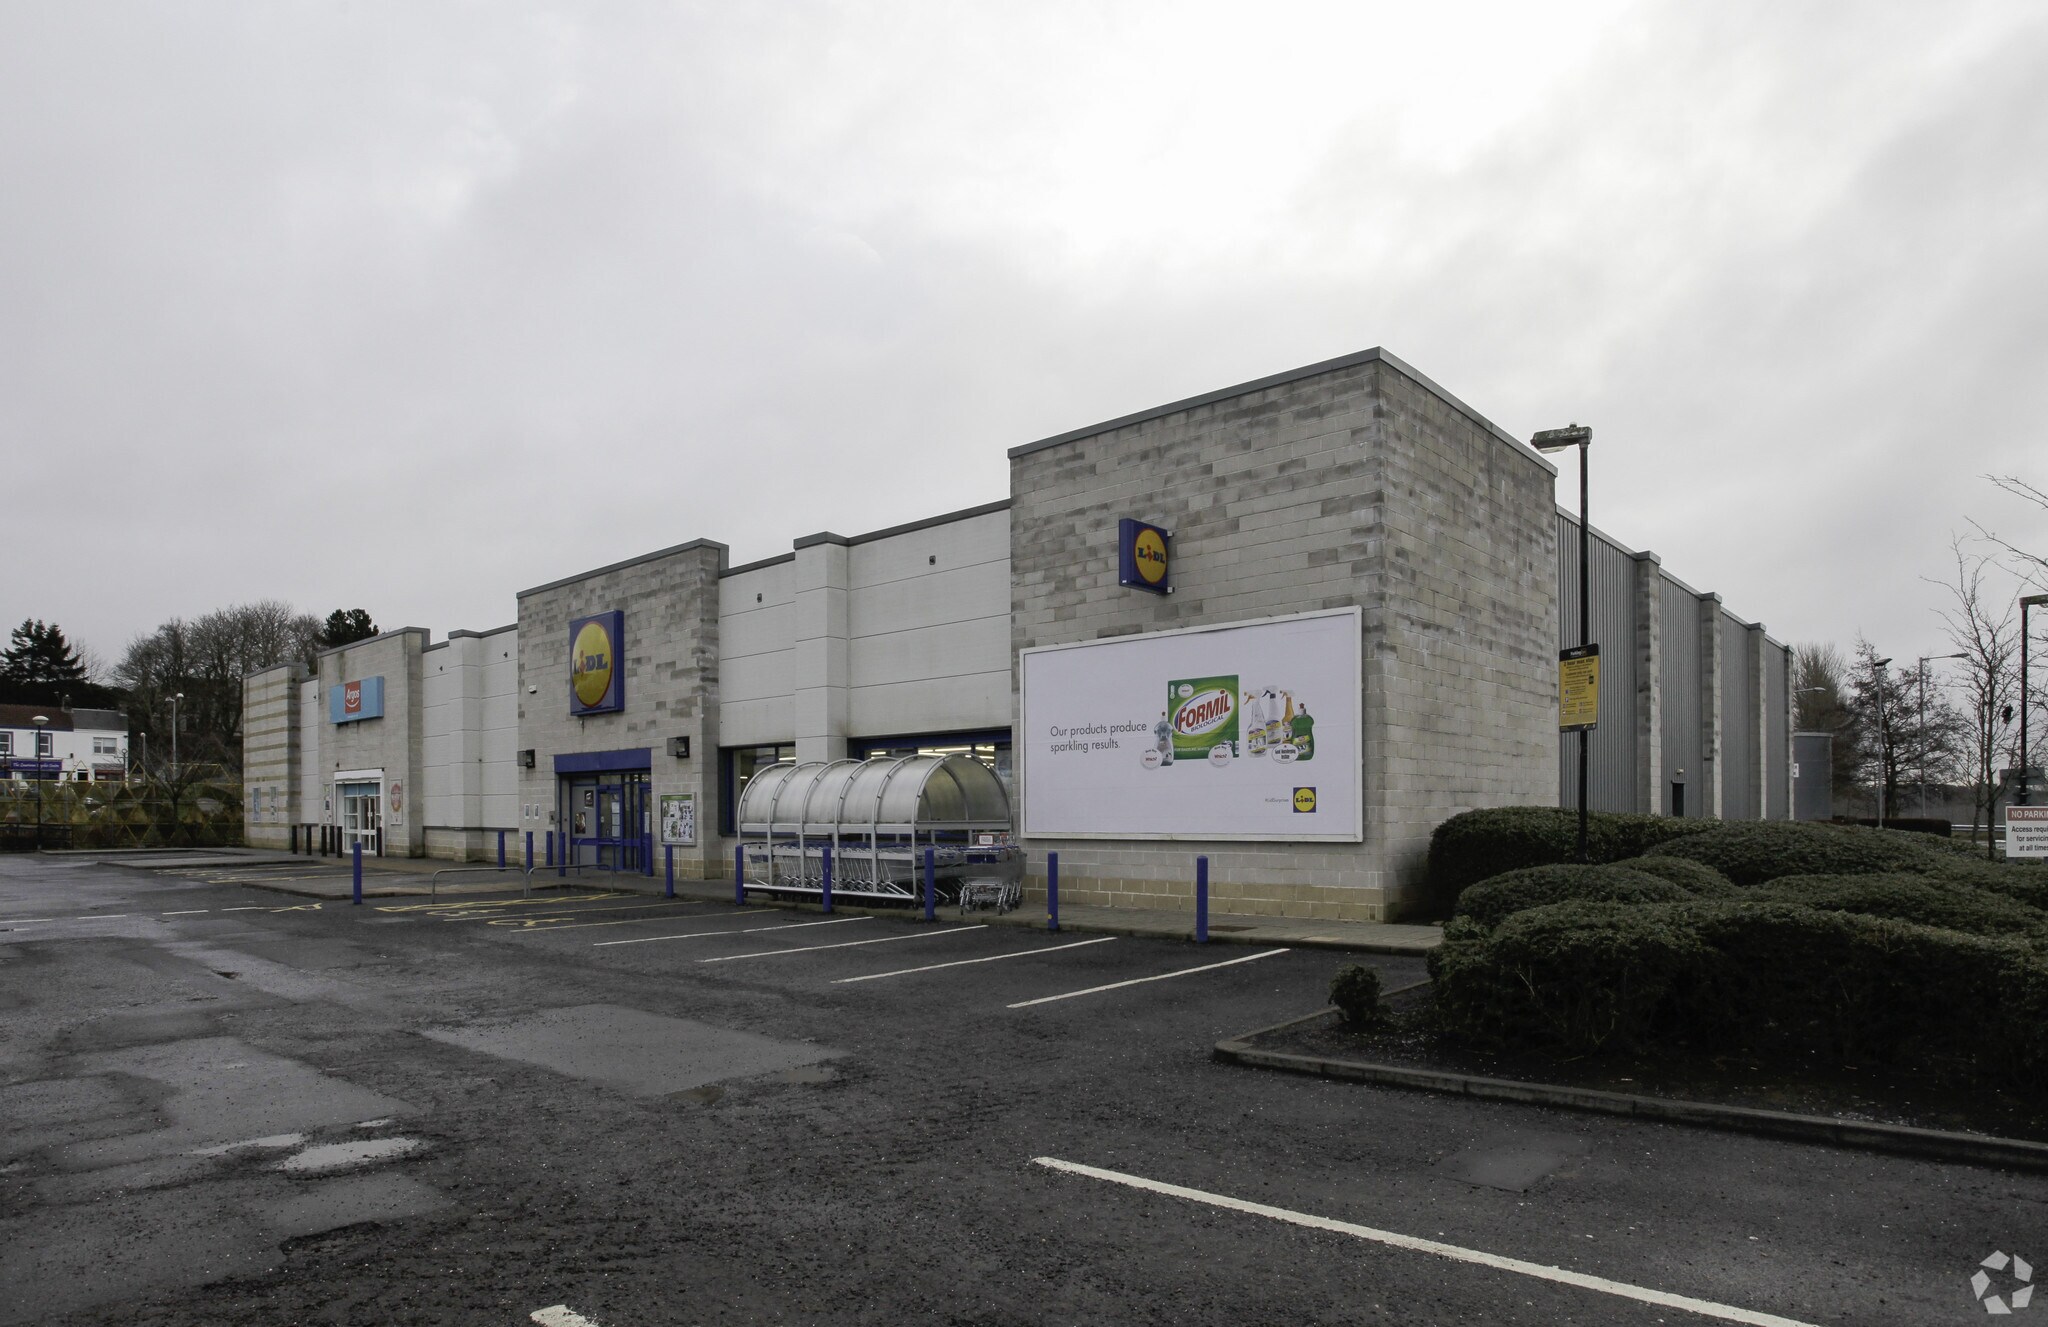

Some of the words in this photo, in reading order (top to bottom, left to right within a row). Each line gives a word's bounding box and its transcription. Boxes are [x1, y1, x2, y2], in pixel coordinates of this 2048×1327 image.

[1137, 545, 1166, 564] LIDL
[573, 650, 608, 677] LIDL
[345, 689, 360, 702] Argos
[1178, 689, 1230, 732] FORMIL
[1050, 726, 1068, 737] Our
[1070, 723, 1107, 738] products
[1110, 721, 1147, 736] produce
[1191, 715, 1224, 732] BIOLOGICAL
[1050, 740, 1089, 754] sparkling
[1092, 738, 1121, 750] results.
